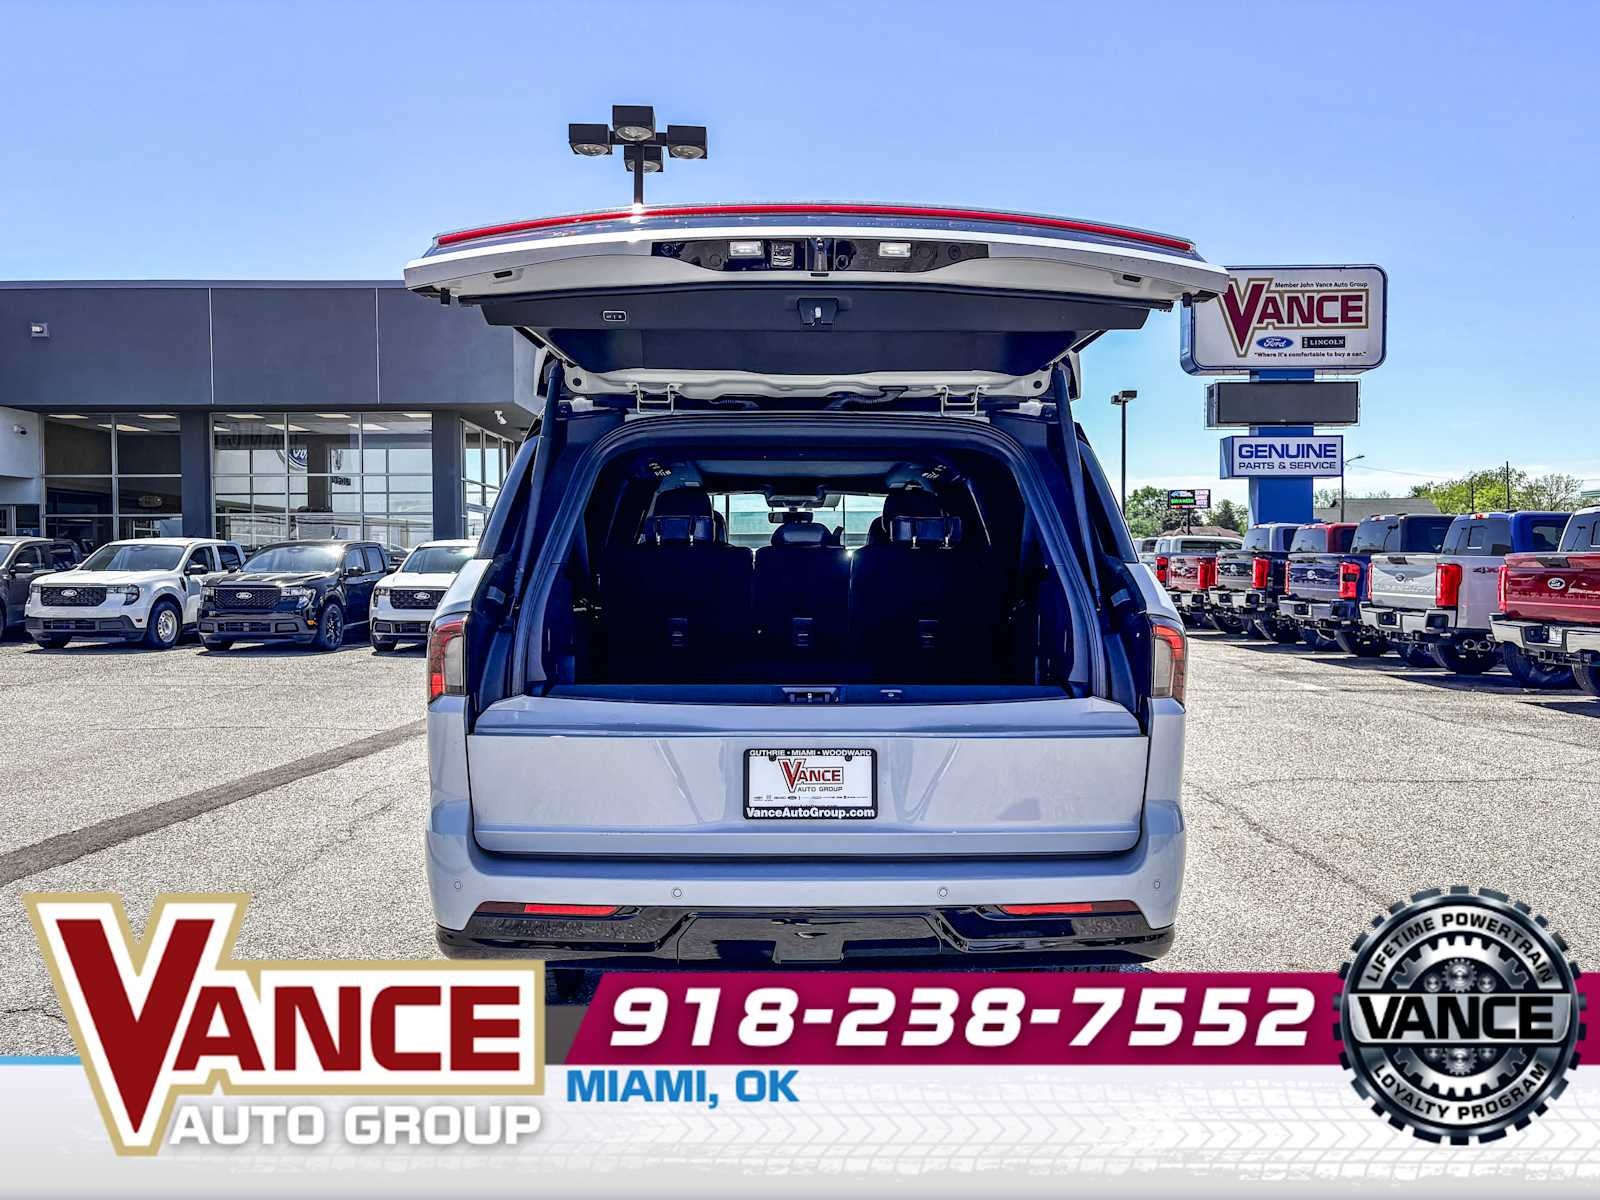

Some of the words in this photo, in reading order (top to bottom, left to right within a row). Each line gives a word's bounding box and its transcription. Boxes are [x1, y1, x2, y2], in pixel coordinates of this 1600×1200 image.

[1349, 281, 1368, 289] Group
[1221, 282, 1363, 353] VANCE
[1238, 443, 1337, 459] GENUINE
[1238, 462, 1275, 470] PARTS
[1278, 462, 1286, 470] &
[1289, 461, 1337, 470] SERVICE
[781, 760, 842, 789] VANCE
[746, 807, 875, 818] VanceAutoGroup.com
